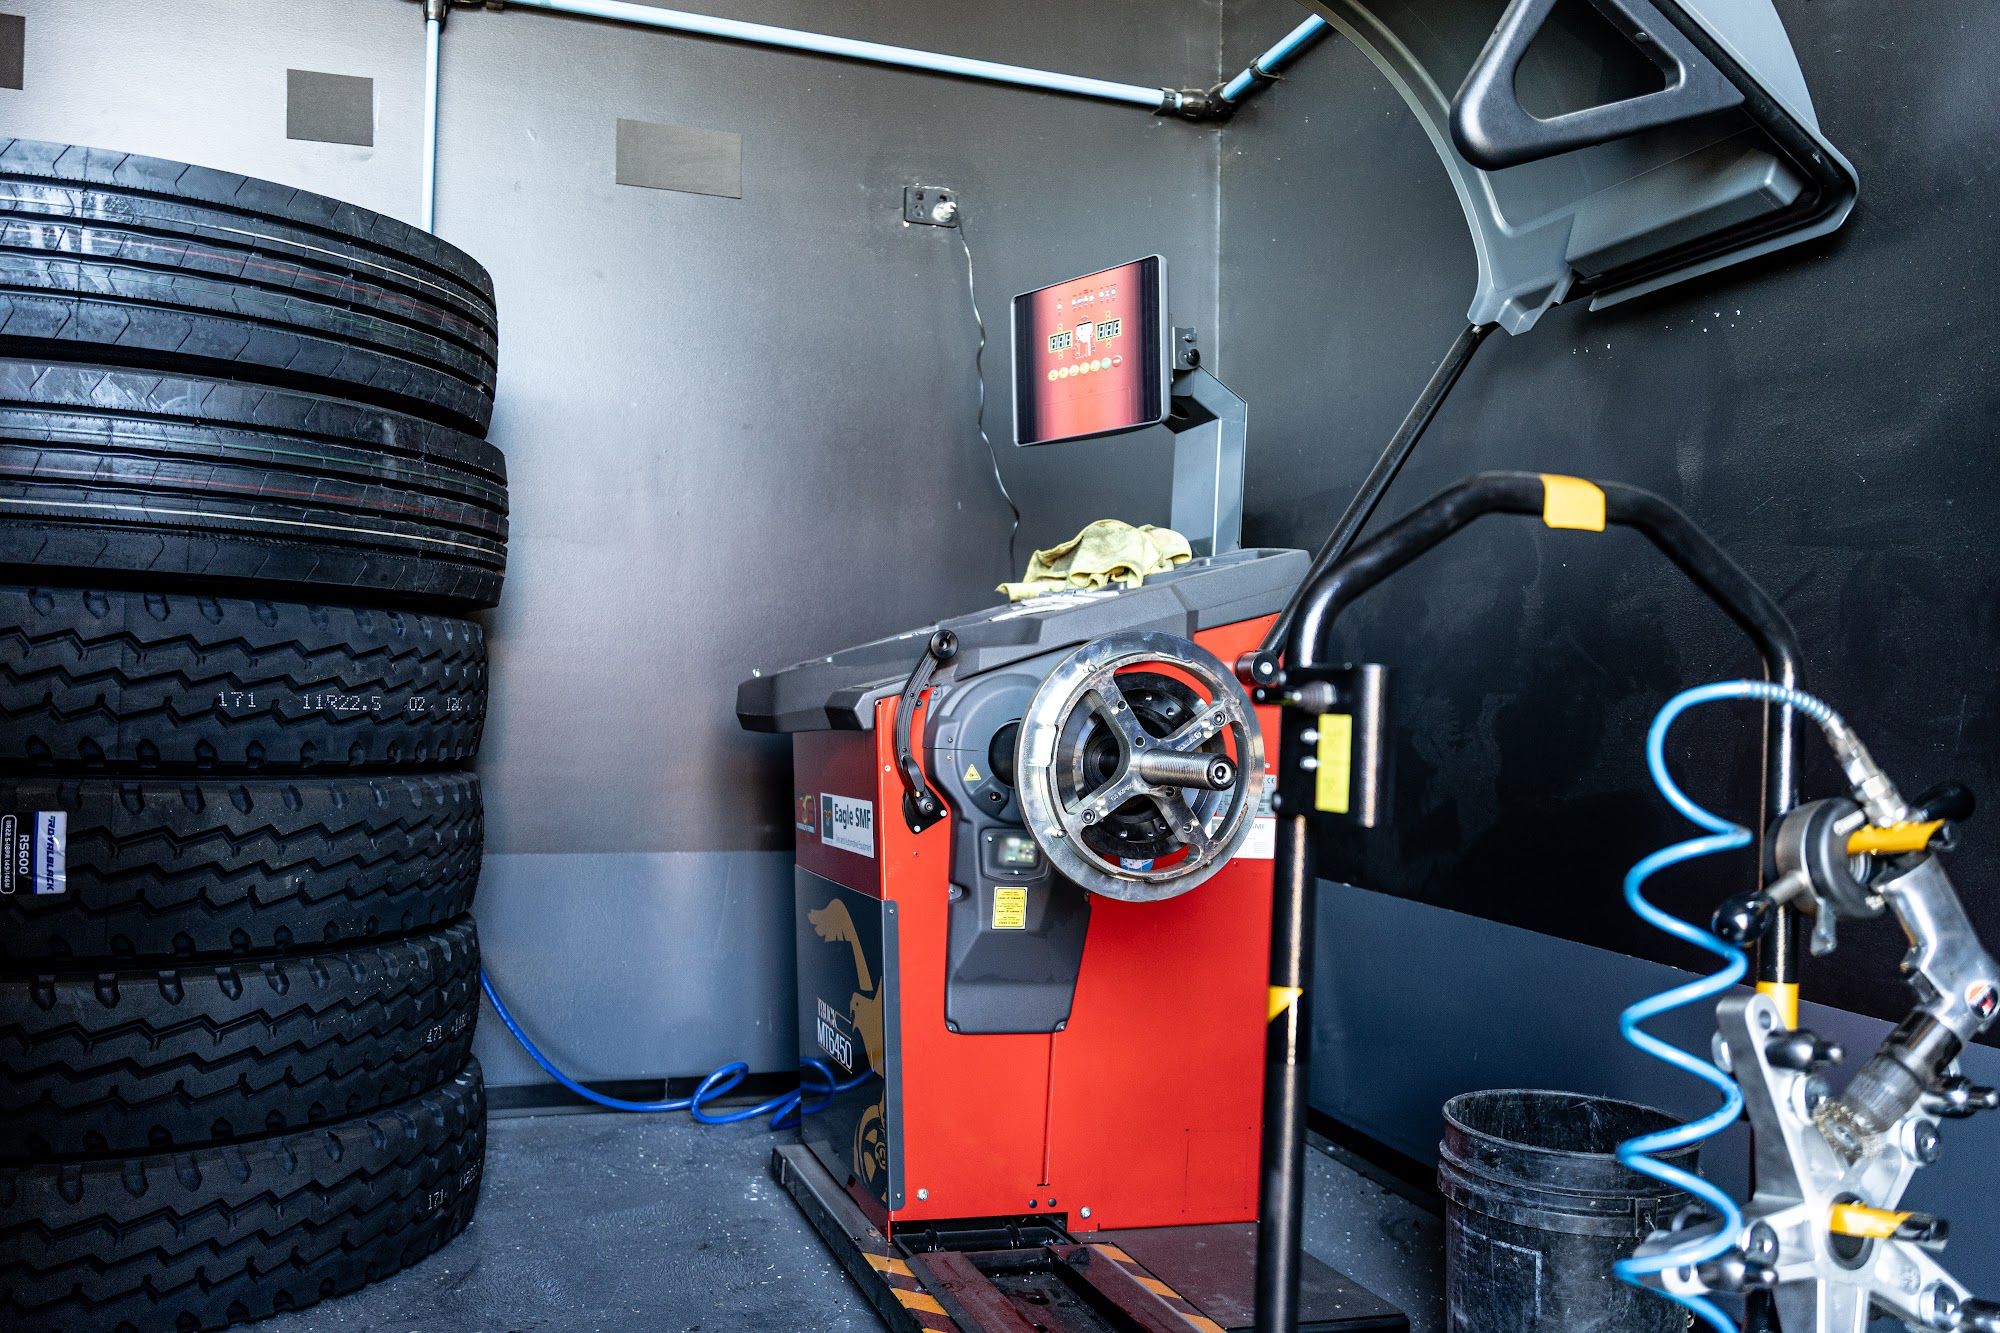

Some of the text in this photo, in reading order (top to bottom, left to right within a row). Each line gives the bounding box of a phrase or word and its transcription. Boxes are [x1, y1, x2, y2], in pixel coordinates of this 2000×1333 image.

[218, 691, 256, 708] 171
[303, 694, 382, 711] 11R22.5
[834, 803, 854, 830] Eagle
[855, 807, 871, 829] SMF
[18, 834, 30, 875] RS600
[46, 816, 56, 892] ROYALBLACK
[817, 997, 838, 1029] TRUCK
[817, 1017, 853, 1070] MT6450
